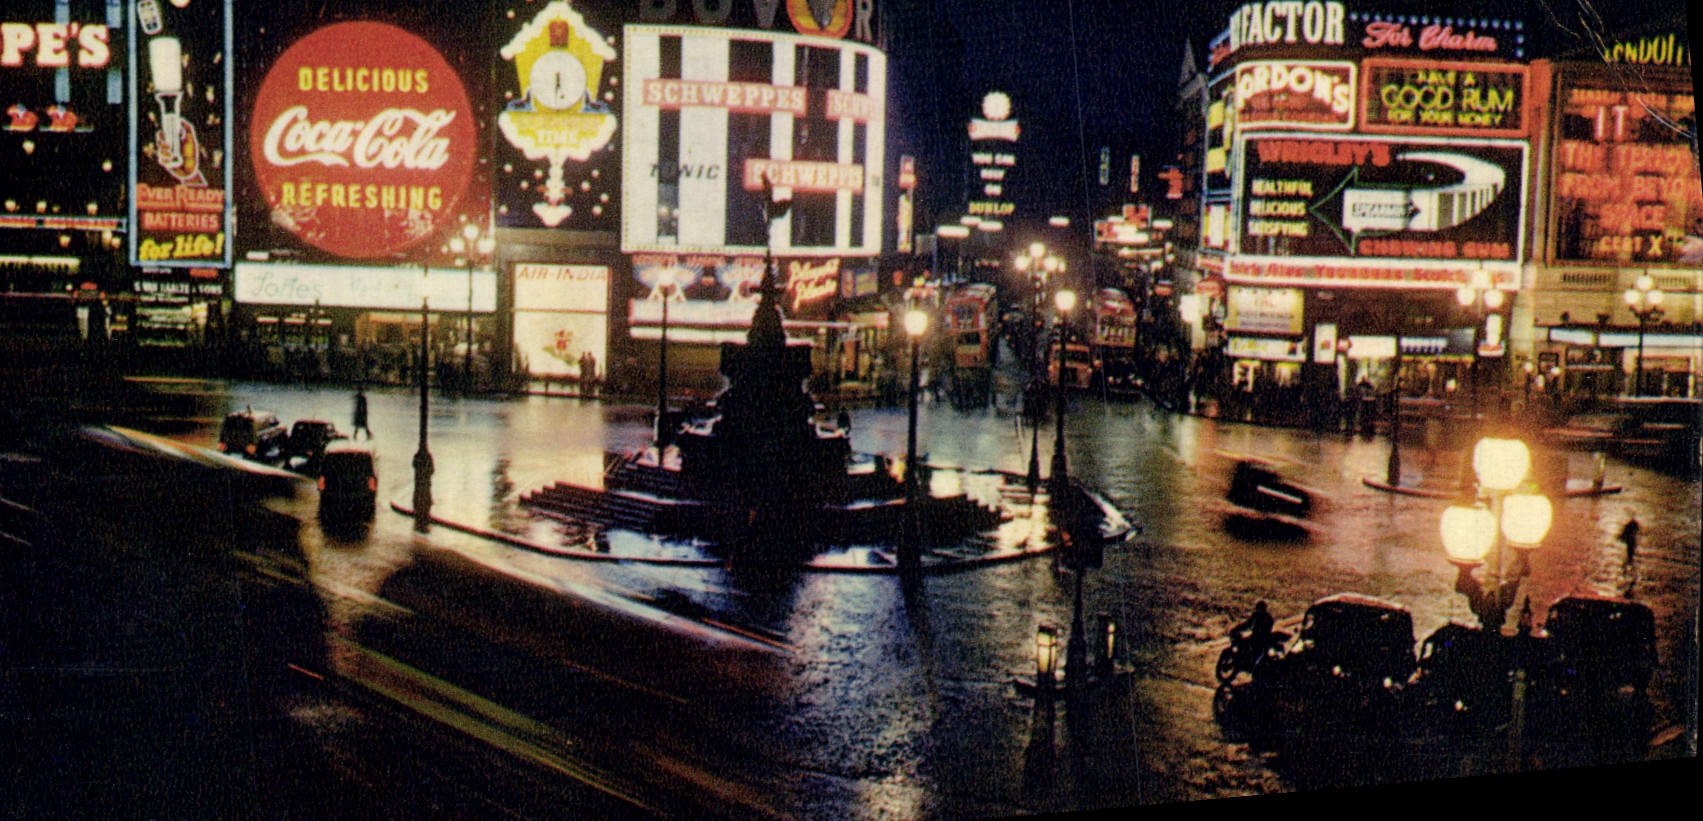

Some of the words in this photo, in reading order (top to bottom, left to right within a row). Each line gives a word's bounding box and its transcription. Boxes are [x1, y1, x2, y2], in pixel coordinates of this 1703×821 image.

[1241, 1, 1346, 45] FACTOR
[1362, 22, 1413, 48] For
[1418, 25, 1498, 51] Charm
[0, 22, 110, 67] PE'S
[298, 67, 430, 93] DELICIOUS
[1237, 64, 1351, 114] ORDON'S
[647, 81, 805, 111] SCHWEPPES
[1382, 84, 1454, 110] GOOD
[1462, 87, 1514, 113] RUM
[1387, 109, 1412, 122] FOR
[1419, 110, 1454, 124] YOUR
[1457, 112, 1503, 126] MONEY
[263, 105, 457, 170] Coca-Cola
[175, 185, 224, 209] READY
[282, 182, 443, 210] REFRESHING
[969, 202, 1015, 216] DUNLOP
[142, 212, 220, 232] BATTERIES
[139, 238, 174, 261] for
[173, 232, 225, 259] life!
[1359, 239, 1456, 257] CHEWING
[1462, 241, 1510, 258] GUM
[1648, 235, 1663, 256] X
[517, 266, 607, 281] AIR-INDIA
